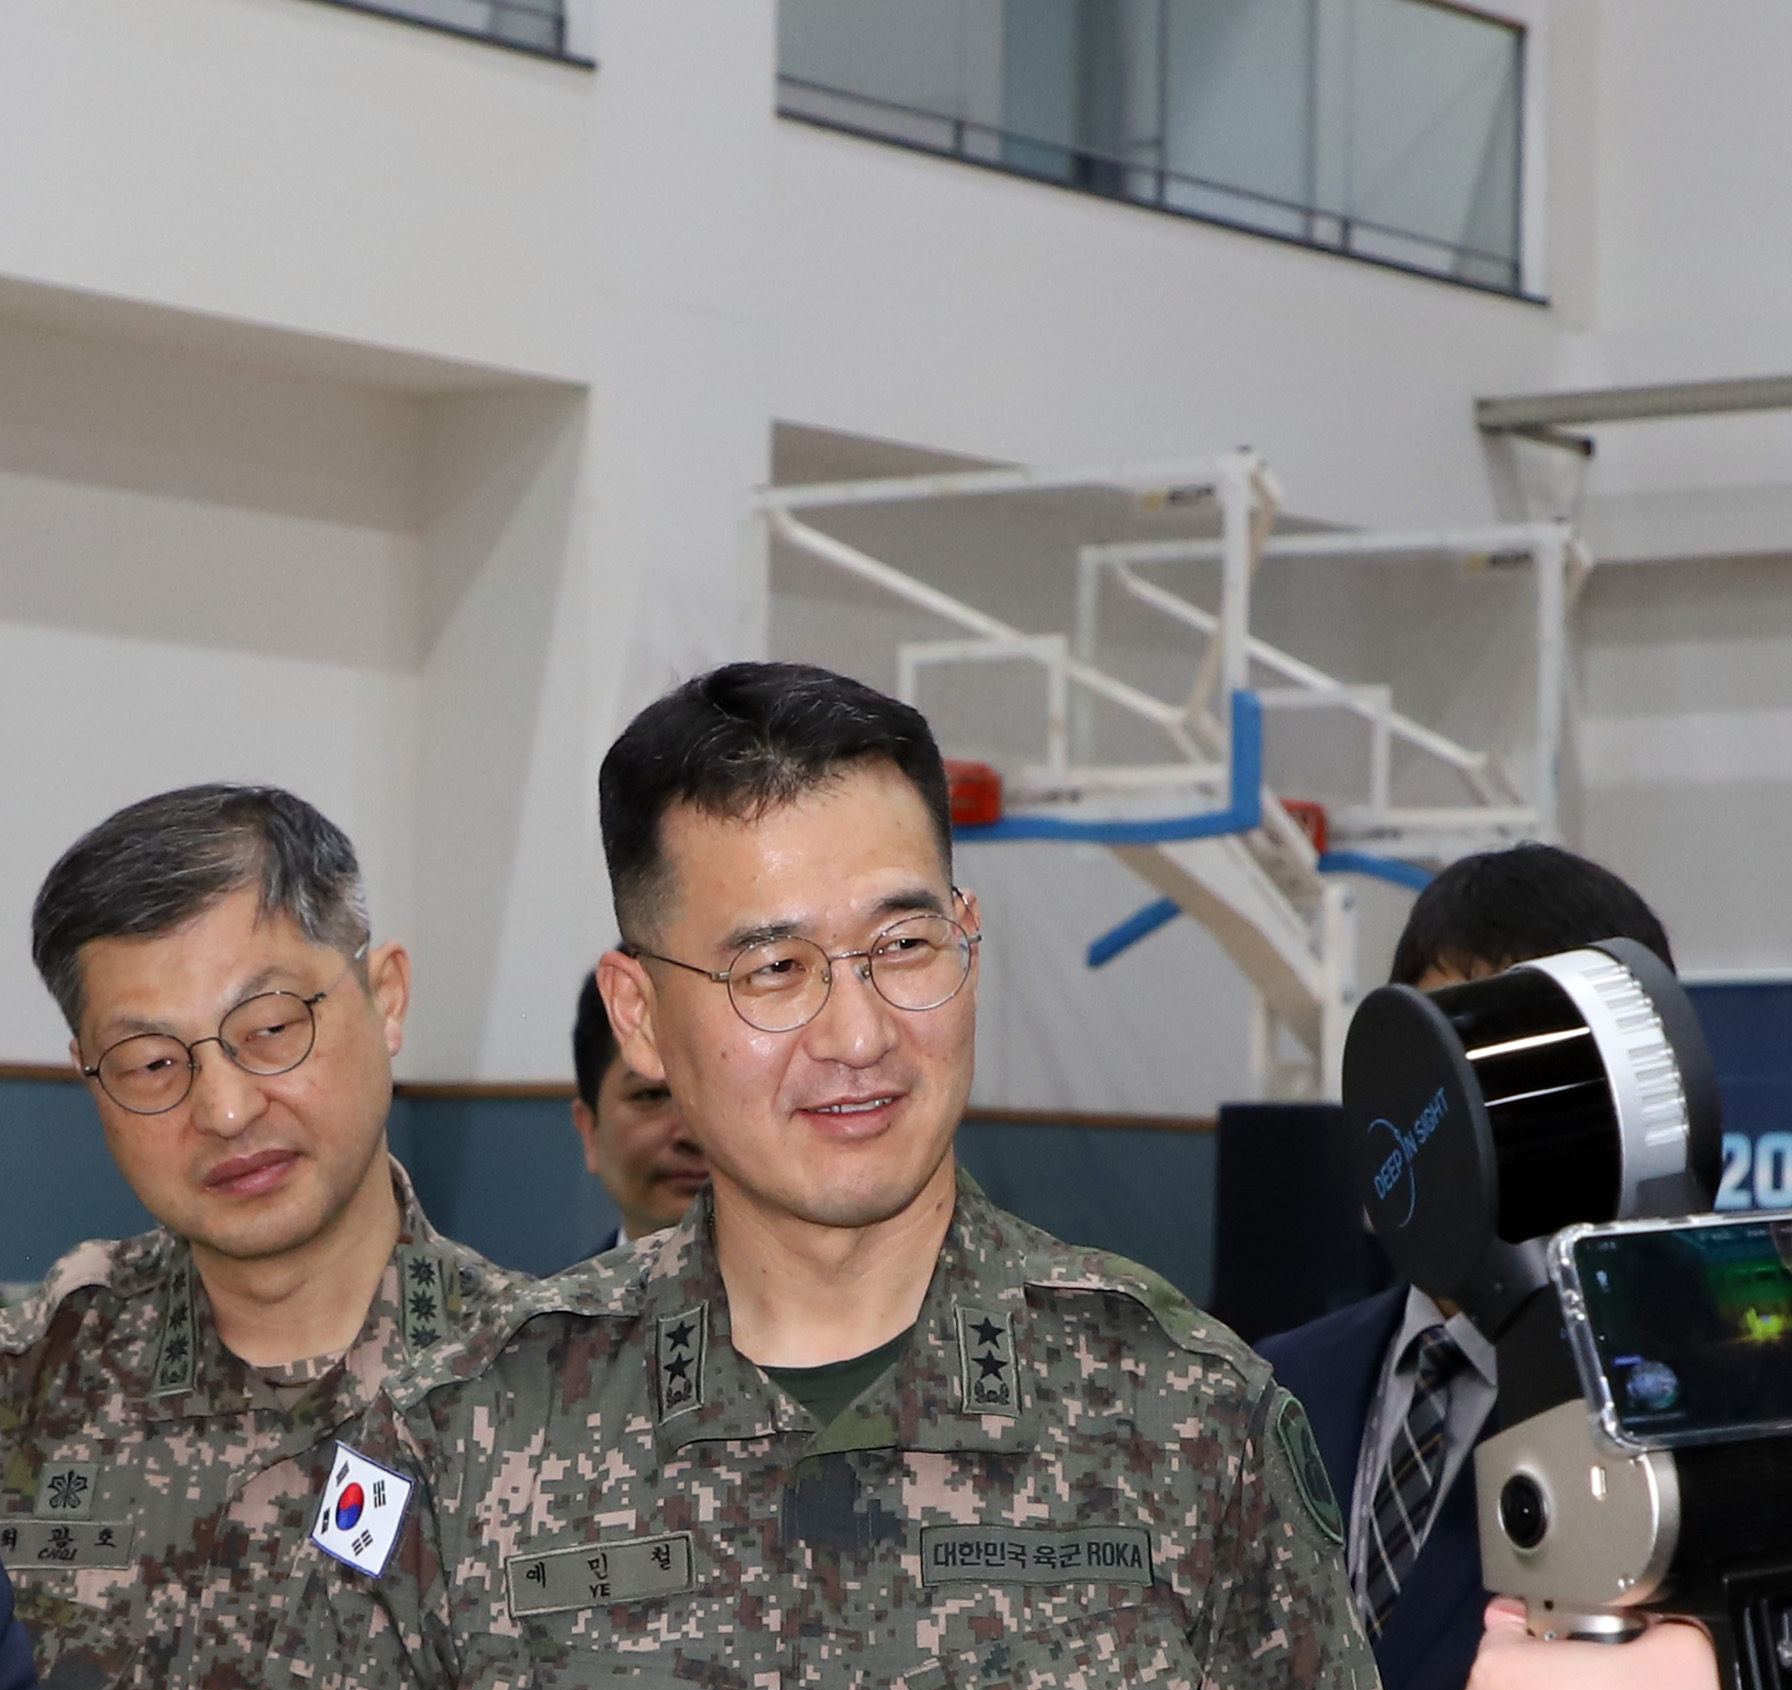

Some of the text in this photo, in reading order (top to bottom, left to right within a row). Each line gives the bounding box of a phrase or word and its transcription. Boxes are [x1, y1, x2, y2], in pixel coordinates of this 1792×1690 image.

[1374, 1149, 1403, 1200] DEEP
[1414, 1087, 1449, 1143] SIGHT
[933, 1541, 1143, 1569] 대한민국 육군 ROKA
[589, 1583, 611, 1598] YE
